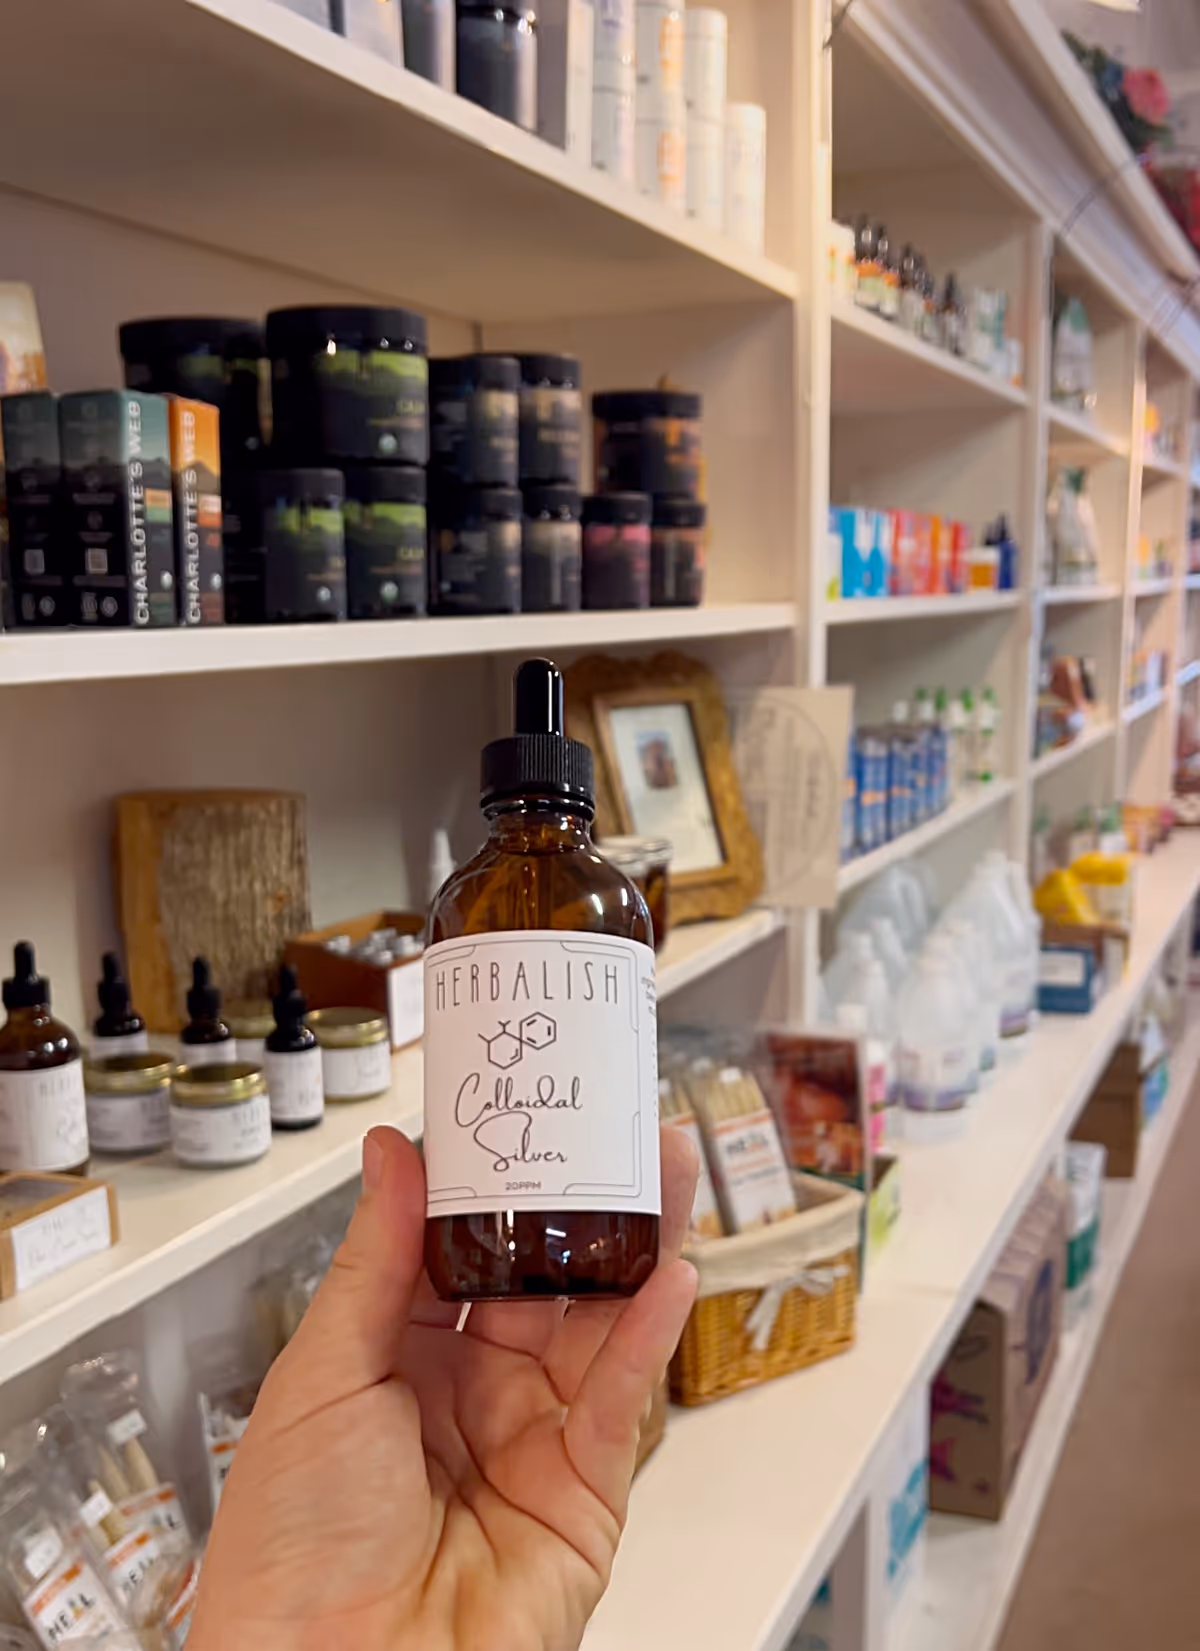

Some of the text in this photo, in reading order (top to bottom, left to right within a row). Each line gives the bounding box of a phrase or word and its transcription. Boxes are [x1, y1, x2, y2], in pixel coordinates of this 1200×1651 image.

[128, 400, 149, 624] CHARLOTTE'S WEB
[182, 410, 201, 624] CHARLOTTE'S WEB
[436, 961, 618, 1010] HERBALISH
[455, 1072, 583, 1128] Colloidal
[473, 1111, 568, 1172] Silver
